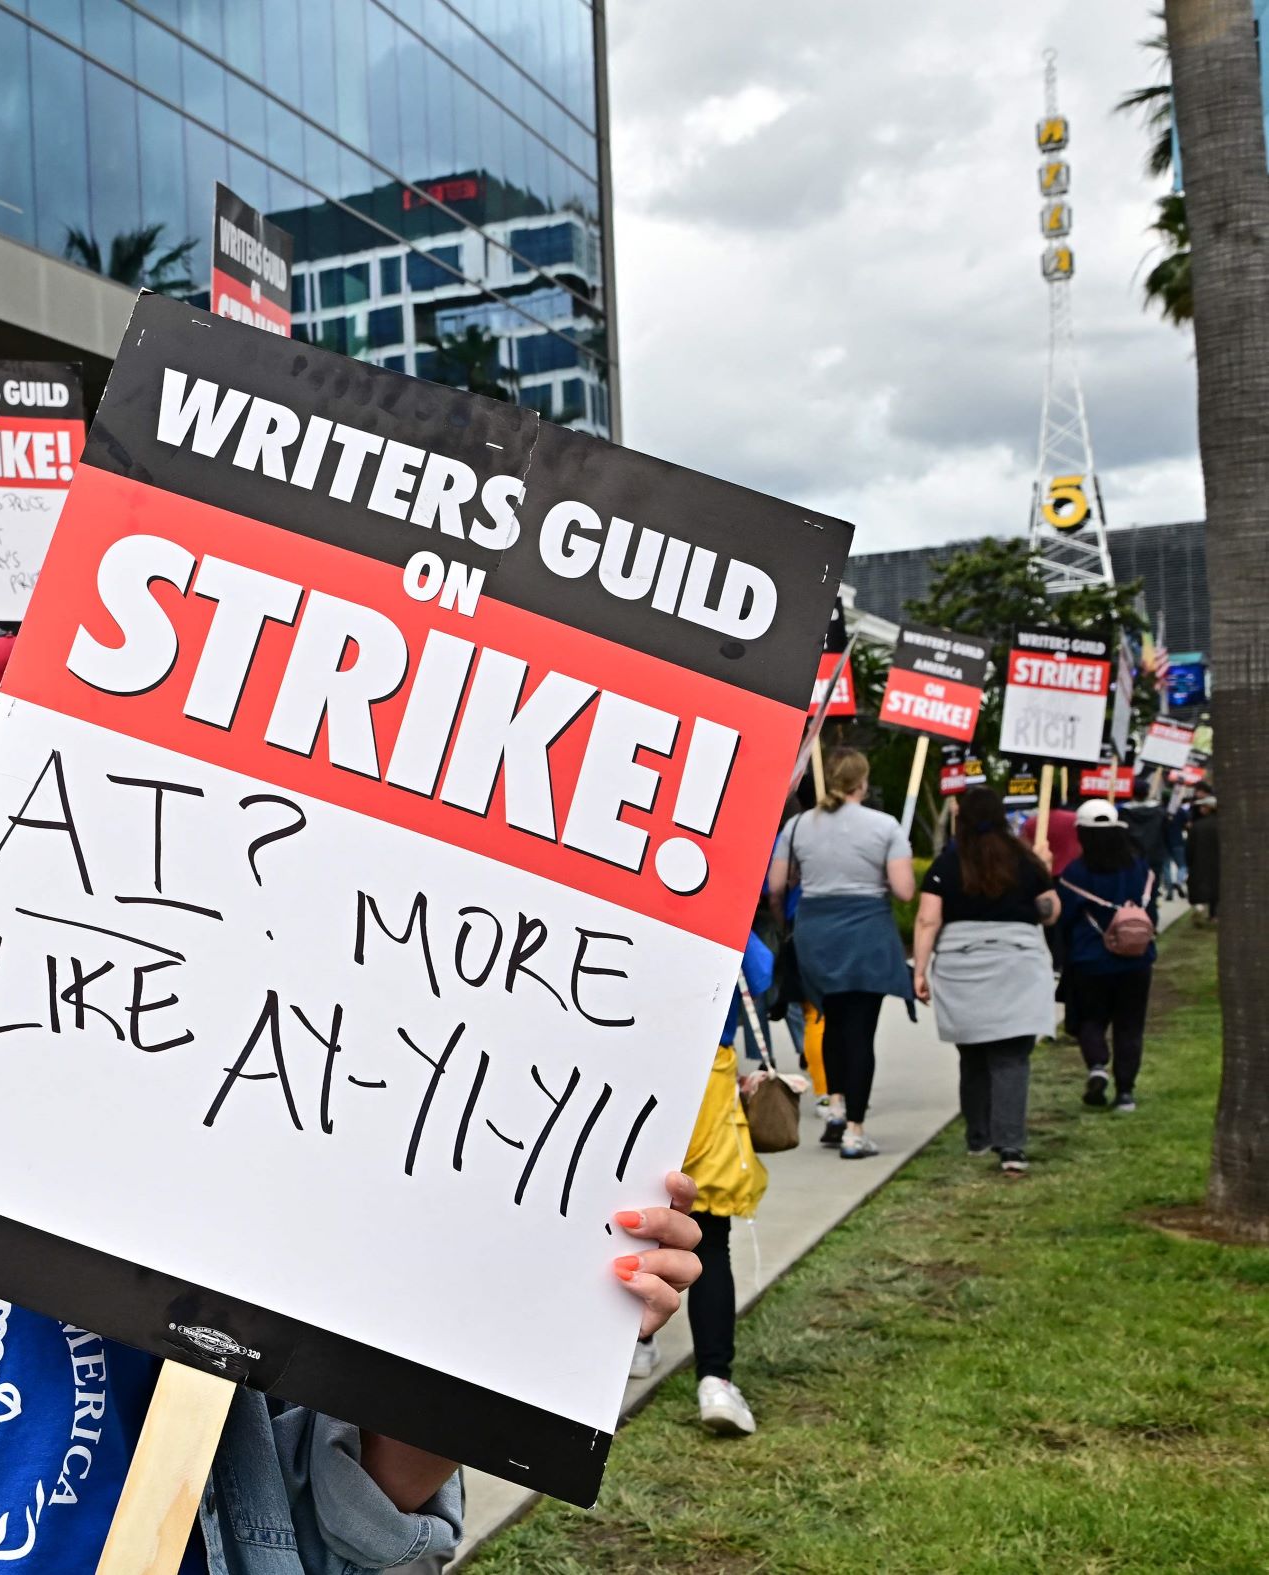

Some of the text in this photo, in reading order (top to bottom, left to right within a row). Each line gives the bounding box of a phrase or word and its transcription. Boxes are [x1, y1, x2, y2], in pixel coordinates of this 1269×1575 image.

[220, 216, 287, 292] WRITERS GUILD
[3, 380, 69, 407] GUILD
[155, 367, 779, 641] WRITERS GUILD
[1041, 475, 1089, 528] 5
[401, 550, 487, 619] ON
[903, 630, 985, 660] WRITERS GUILD
[1018, 632, 1070, 652] WRITERS
[912, 659, 963, 680] AMERICA
[1013, 657, 1103, 693] STRIKE!
[924, 683, 946, 698] ON
[65, 534, 742, 897] STRIKE!
[886, 690, 972, 730] STRIKE!
[1013, 717, 1077, 751] RICH
[354, 889, 635, 1028] MORE
[247, 1349, 261, 1360] 320
[48, 1320, 107, 1507] MERICA
